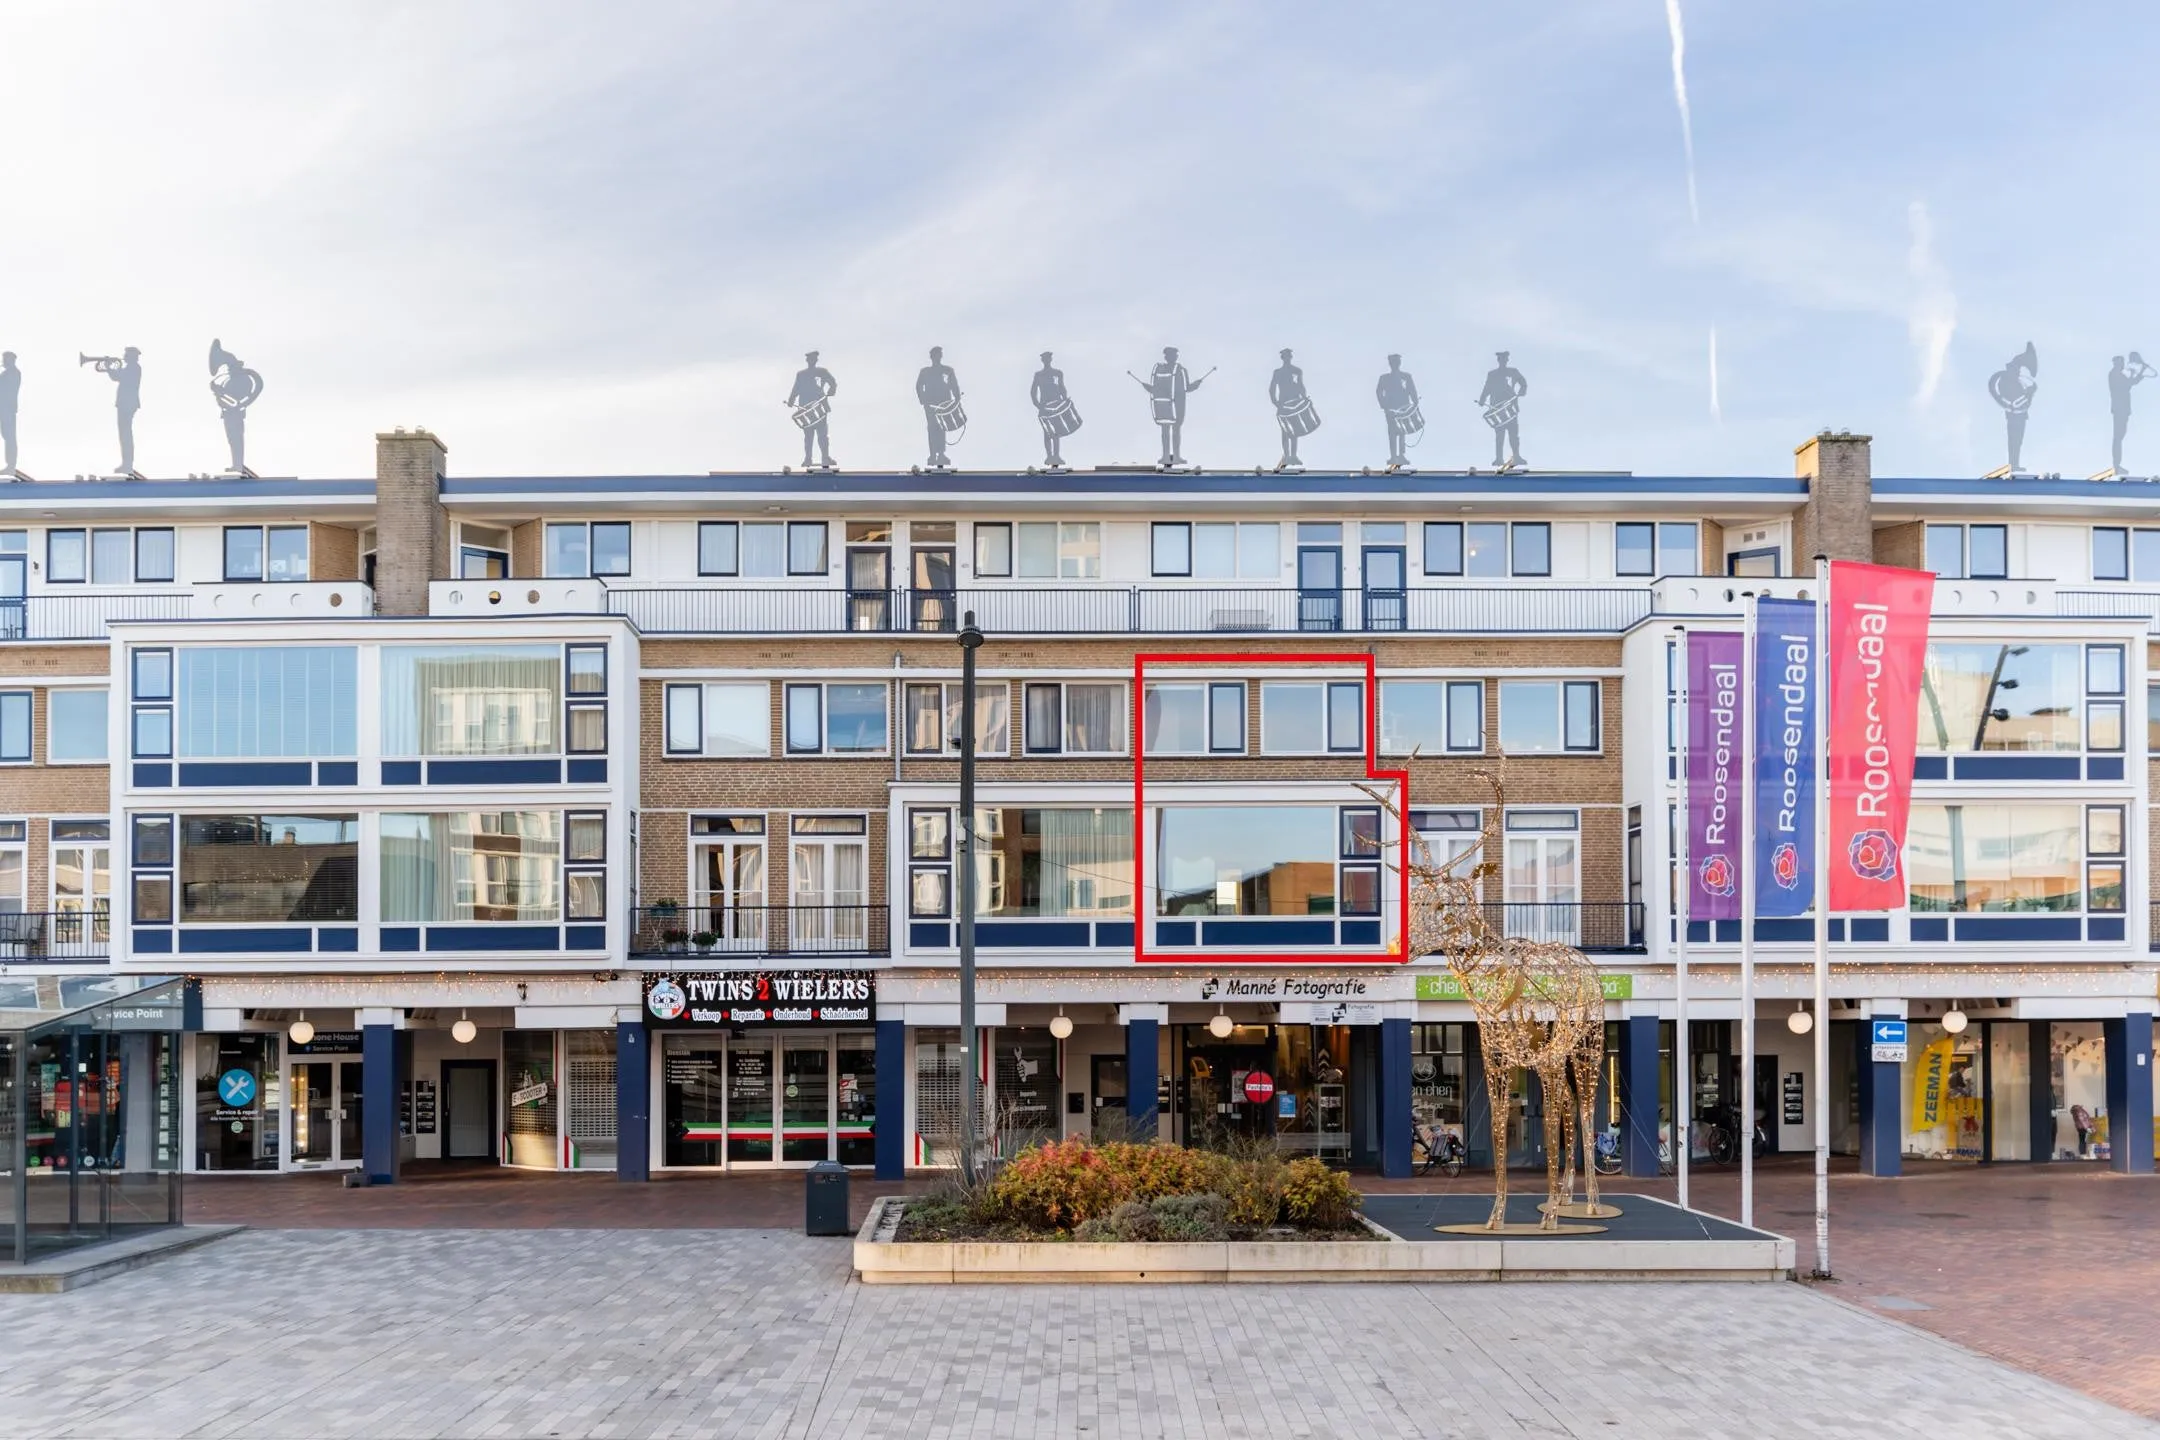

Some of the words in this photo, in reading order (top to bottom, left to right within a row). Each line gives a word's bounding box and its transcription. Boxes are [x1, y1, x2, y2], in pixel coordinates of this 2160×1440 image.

[1780, 634, 1808, 832] Roosendaal
[1706, 664, 1736, 845] Roosendaal
[686, 973, 754, 1000] TWINS
[757, 979, 769, 1000] 2
[773, 972, 869, 1000] WIELERS
[1227, 978, 1276, 995] Manné
[1283, 978, 1366, 999] Fotografie
[136, 1008, 163, 1018] Point
[692, 1008, 721, 1022] Verkoop
[732, 1008, 765, 1021] Reparatie
[774, 1008, 812, 1019] Onderhoud
[821, 1008, 868, 1019] Schadeherstel
[333, 1032, 359, 1041] House
[1924, 1053, 1942, 1122] ZEEMAN
